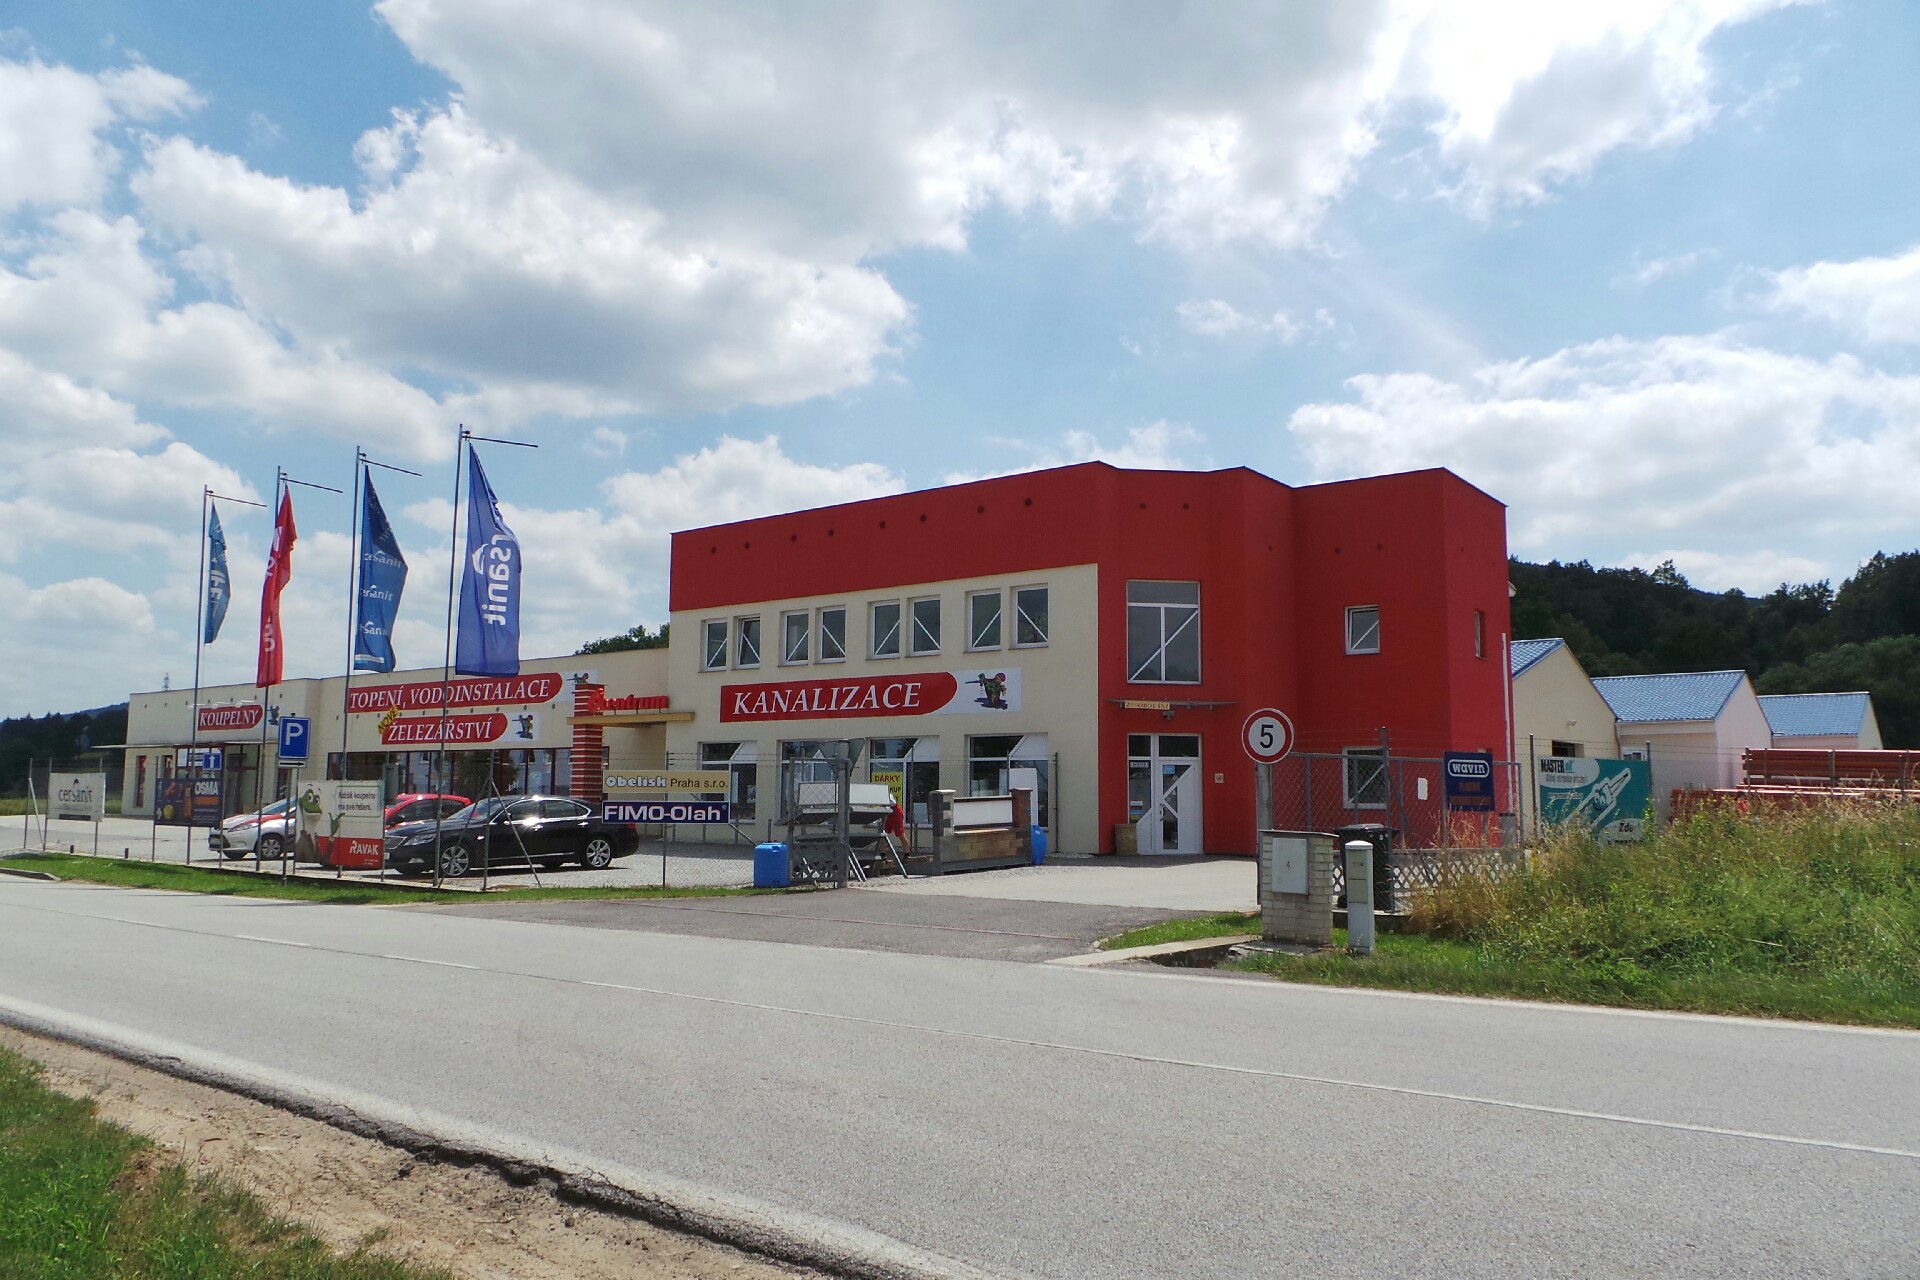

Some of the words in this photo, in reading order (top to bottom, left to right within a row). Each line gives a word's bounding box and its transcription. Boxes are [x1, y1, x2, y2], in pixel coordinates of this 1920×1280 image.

[350, 685, 407, 709] TOPENÍ,
[409, 679, 550, 705] VODOINSTALACE
[732, 682, 922, 715] KANALIZACE
[200, 709, 259, 726] KOUPELNY
[285, 722, 304, 746] P
[387, 716, 493, 742] ŽELEZÁŘSTVÍ
[1259, 724, 1274, 749] 5
[1452, 763, 1486, 774] wavin
[194, 781, 219, 796] OSMA
[605, 776, 667, 788] Obelisk
[670, 778, 700, 788] Praha
[704, 781, 728, 789] s.r.o.
[349, 840, 379, 856] RAVAK
